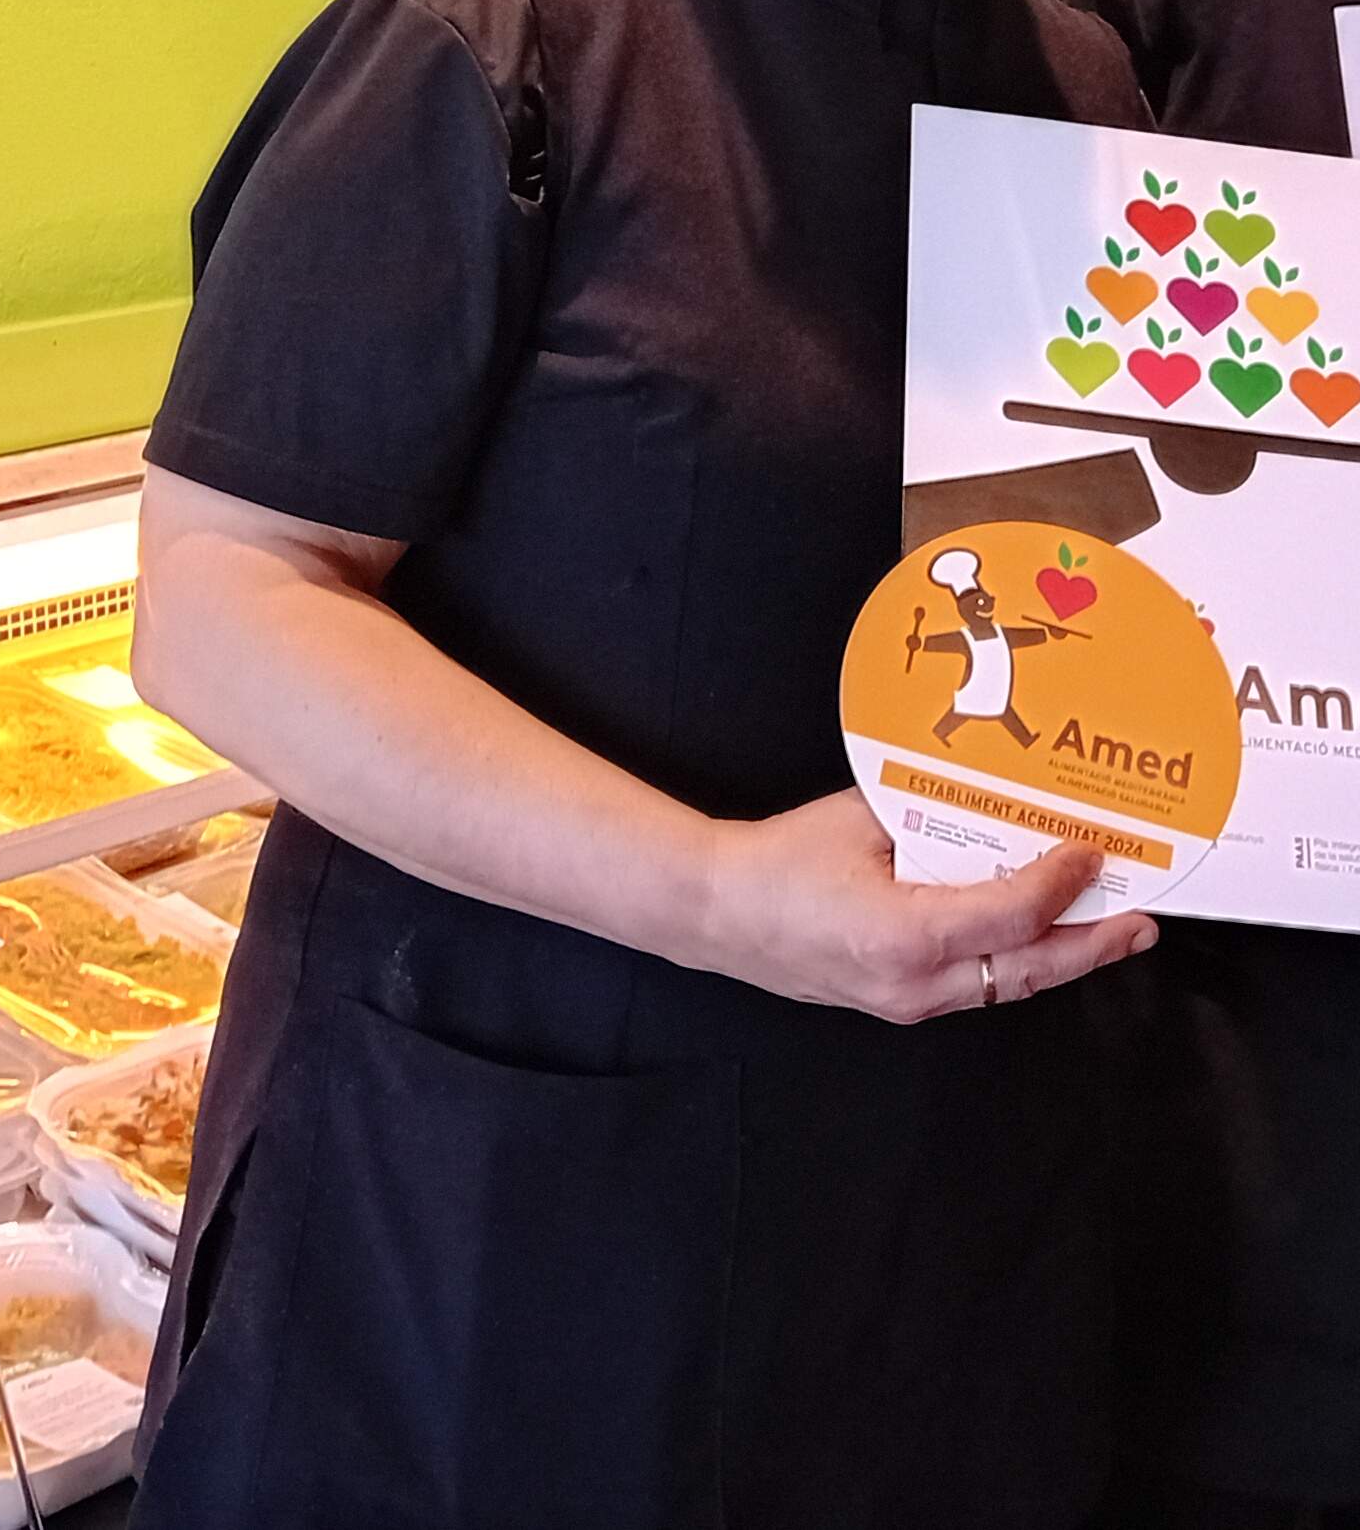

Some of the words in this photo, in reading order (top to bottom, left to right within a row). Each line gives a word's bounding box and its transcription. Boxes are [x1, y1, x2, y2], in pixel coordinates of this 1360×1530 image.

[1051, 718, 1194, 789] Amed
[908, 774, 1013, 819] ESTABLIMENT
[1016, 808, 1099, 846] ACREDITAT
[1104, 834, 1144, 858] 2024
